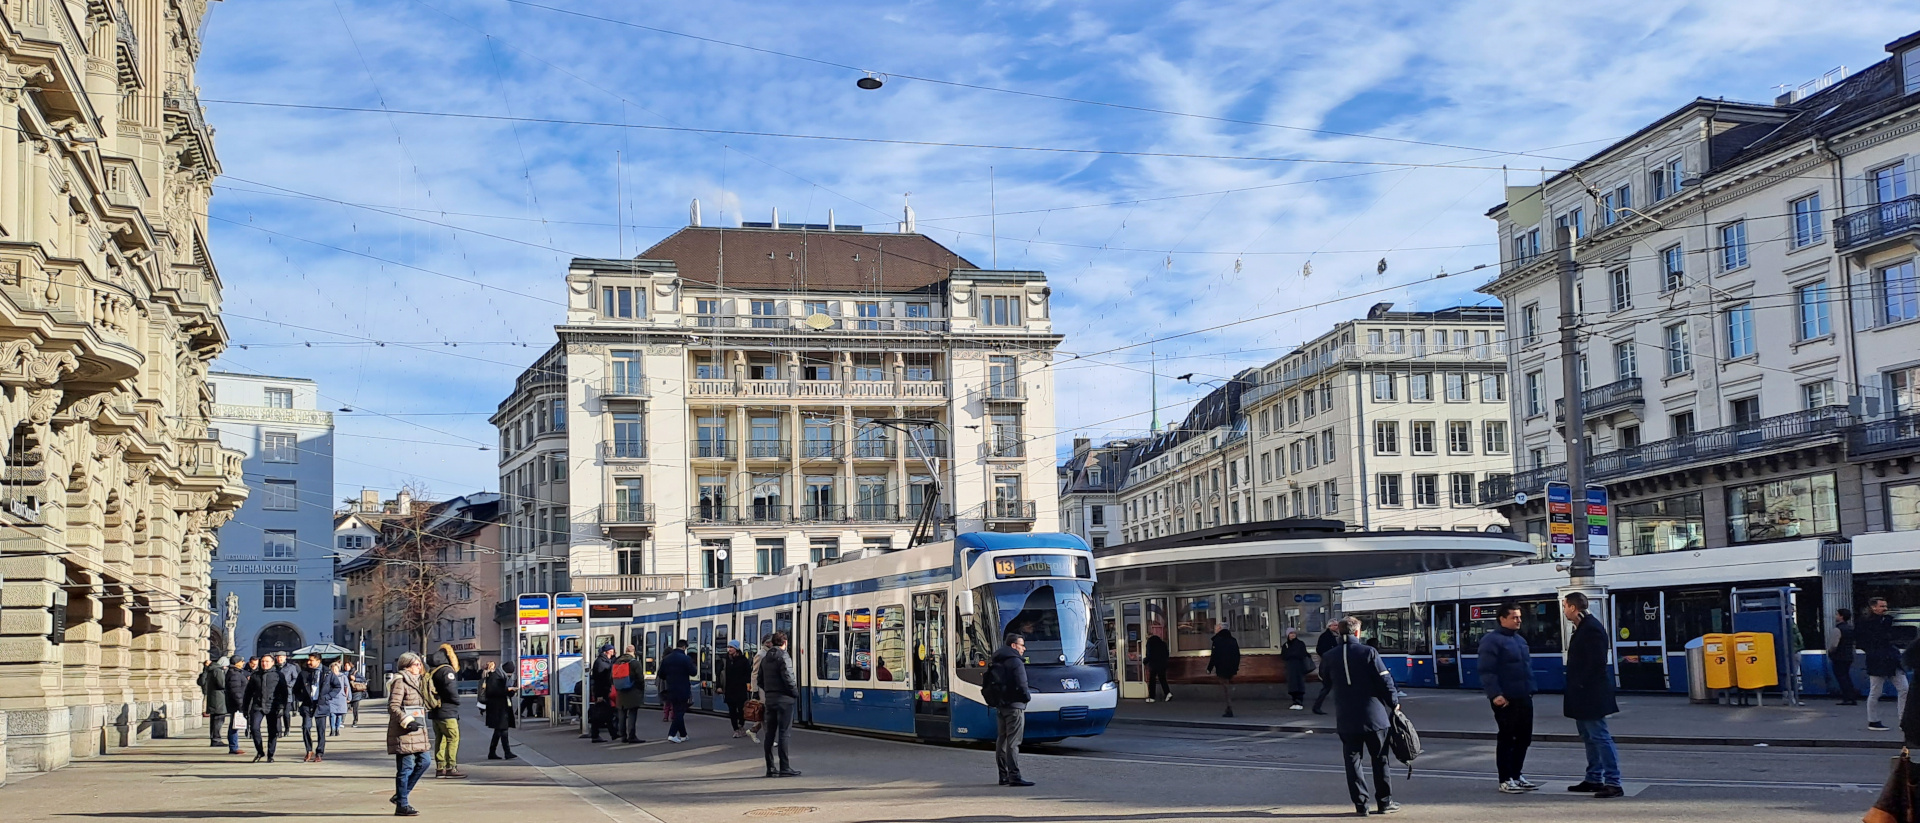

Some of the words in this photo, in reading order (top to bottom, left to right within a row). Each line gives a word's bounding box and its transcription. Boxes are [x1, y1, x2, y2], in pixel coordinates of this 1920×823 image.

[227, 564, 298, 574] ZEUGHAUSKELLER
[999, 560, 1013, 572] 13
[1474, 608, 1479, 618] 2
